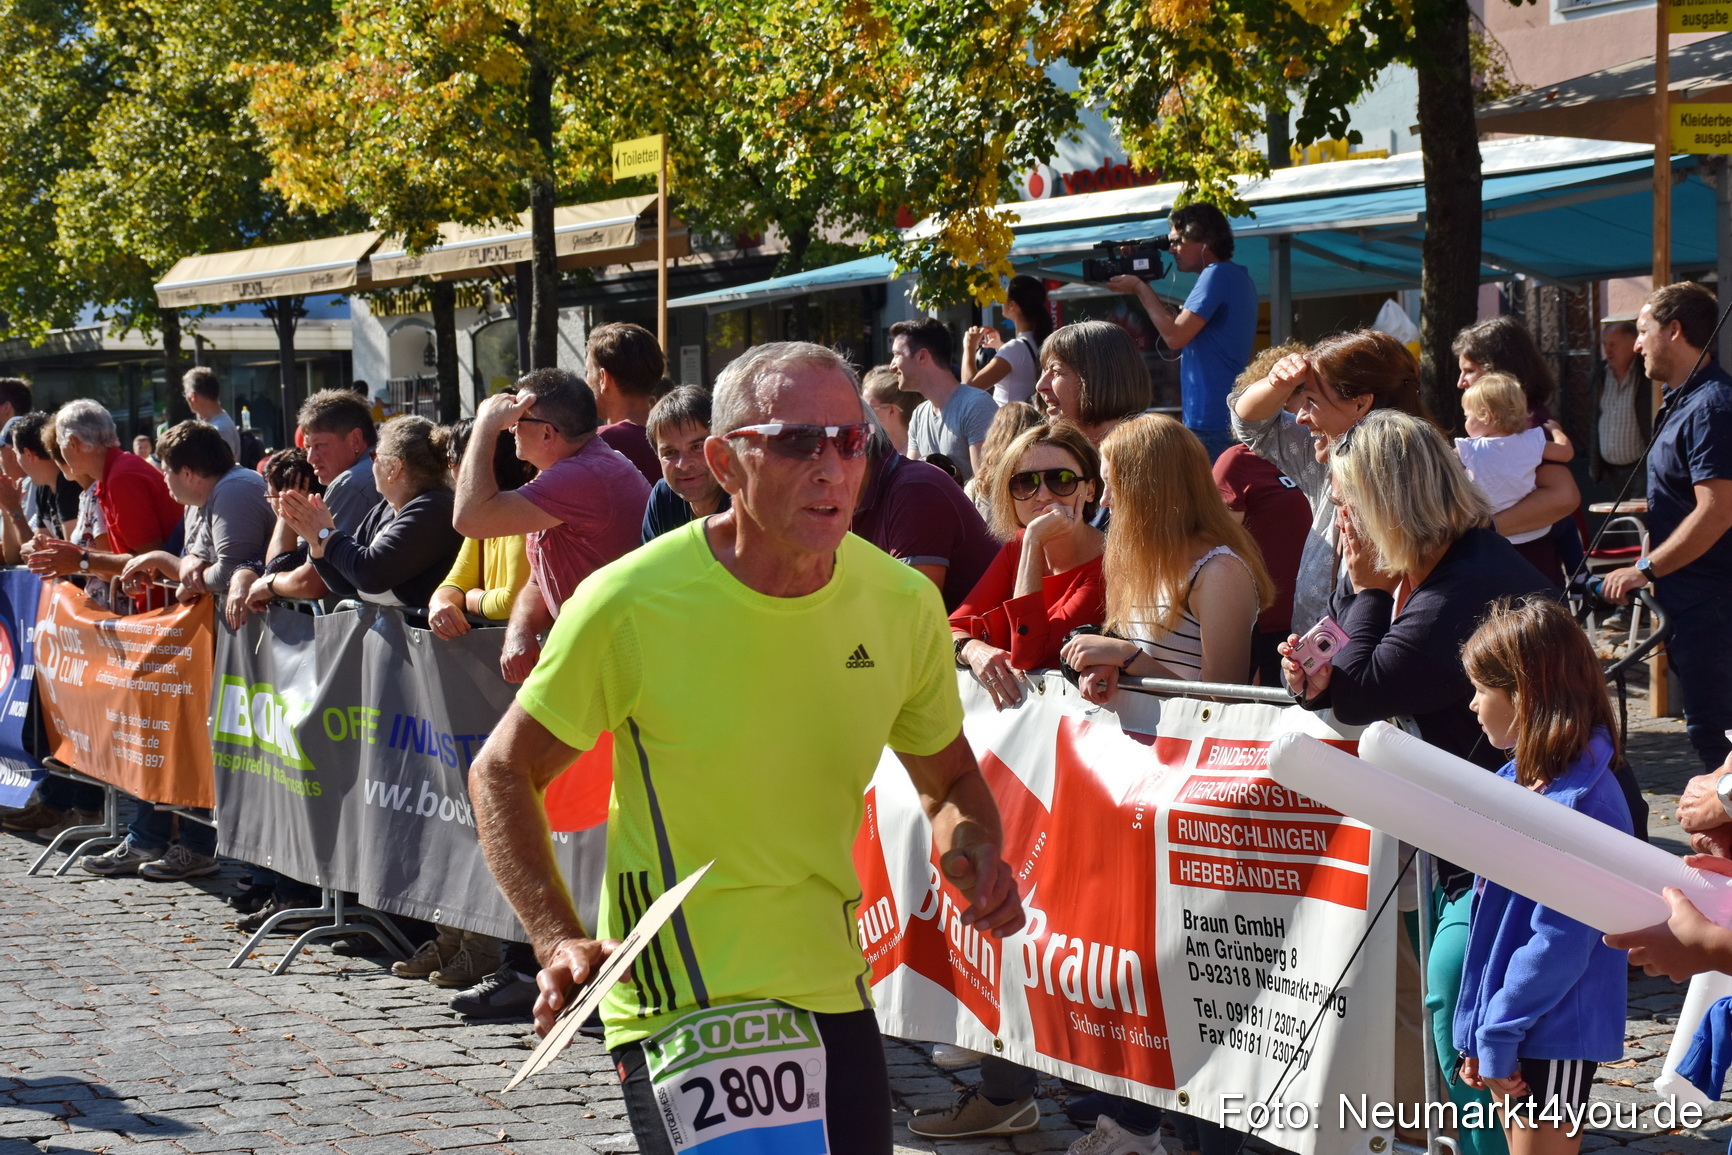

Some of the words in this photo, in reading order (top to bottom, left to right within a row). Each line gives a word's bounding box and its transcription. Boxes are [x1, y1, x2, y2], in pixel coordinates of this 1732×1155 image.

[1682, 9, 1729, 29] ausgabe
[1680, 113, 1732, 127] Kleiderbe
[1694, 131, 1732, 147] ausgab
[622, 149, 659, 167] Toiletten
[60, 625, 85, 655] CODE
[155, 624, 183, 637] Partner
[58, 656, 89, 687] CLINIC
[846, 659, 875, 669] adidas
[162, 681, 194, 698] angeht.
[152, 720, 170, 731] uns:
[218, 683, 308, 761] BOK
[145, 754, 165, 768] 897
[1207, 745, 1271, 767] BINDESTR
[1178, 818, 1327, 852] RUNDSCHLINGEN
[1019, 859, 1035, 880] Seit
[1031, 831, 1047, 858] 1929
[1180, 860, 1301, 891] HEBEBÄNDER
[857, 896, 895, 951] aun
[914, 860, 995, 987] Braun
[1183, 909, 1229, 934] Braun
[1234, 914, 1286, 938] GmbH
[1021, 903, 1148, 1017] Braun
[1186, 935, 1210, 958] Am
[1214, 938, 1287, 971] Grünberg
[1291, 948, 1298, 968] 8
[947, 949, 969, 979] Sicher
[970, 972, 980, 990] ist
[981, 986, 1001, 1012] sicher
[1188, 961, 1251, 987] D-92318
[1070, 1011, 1106, 1038] Sicher
[1110, 1022, 1127, 1041] ist
[1129, 1027, 1169, 1050] sicher
[1194, 997, 1222, 1020] Tel.
[1226, 1001, 1264, 1028] 09181
[1267, 1008, 1273, 1030] /
[1274, 1011, 1306, 1042] 2307-0
[663, 1011, 801, 1061] BOCK
[1198, 1022, 1225, 1046] Fax
[1229, 1027, 1262, 1056] 09181
[1265, 1036, 1271, 1058] /
[680, 1060, 805, 1132] 2800
